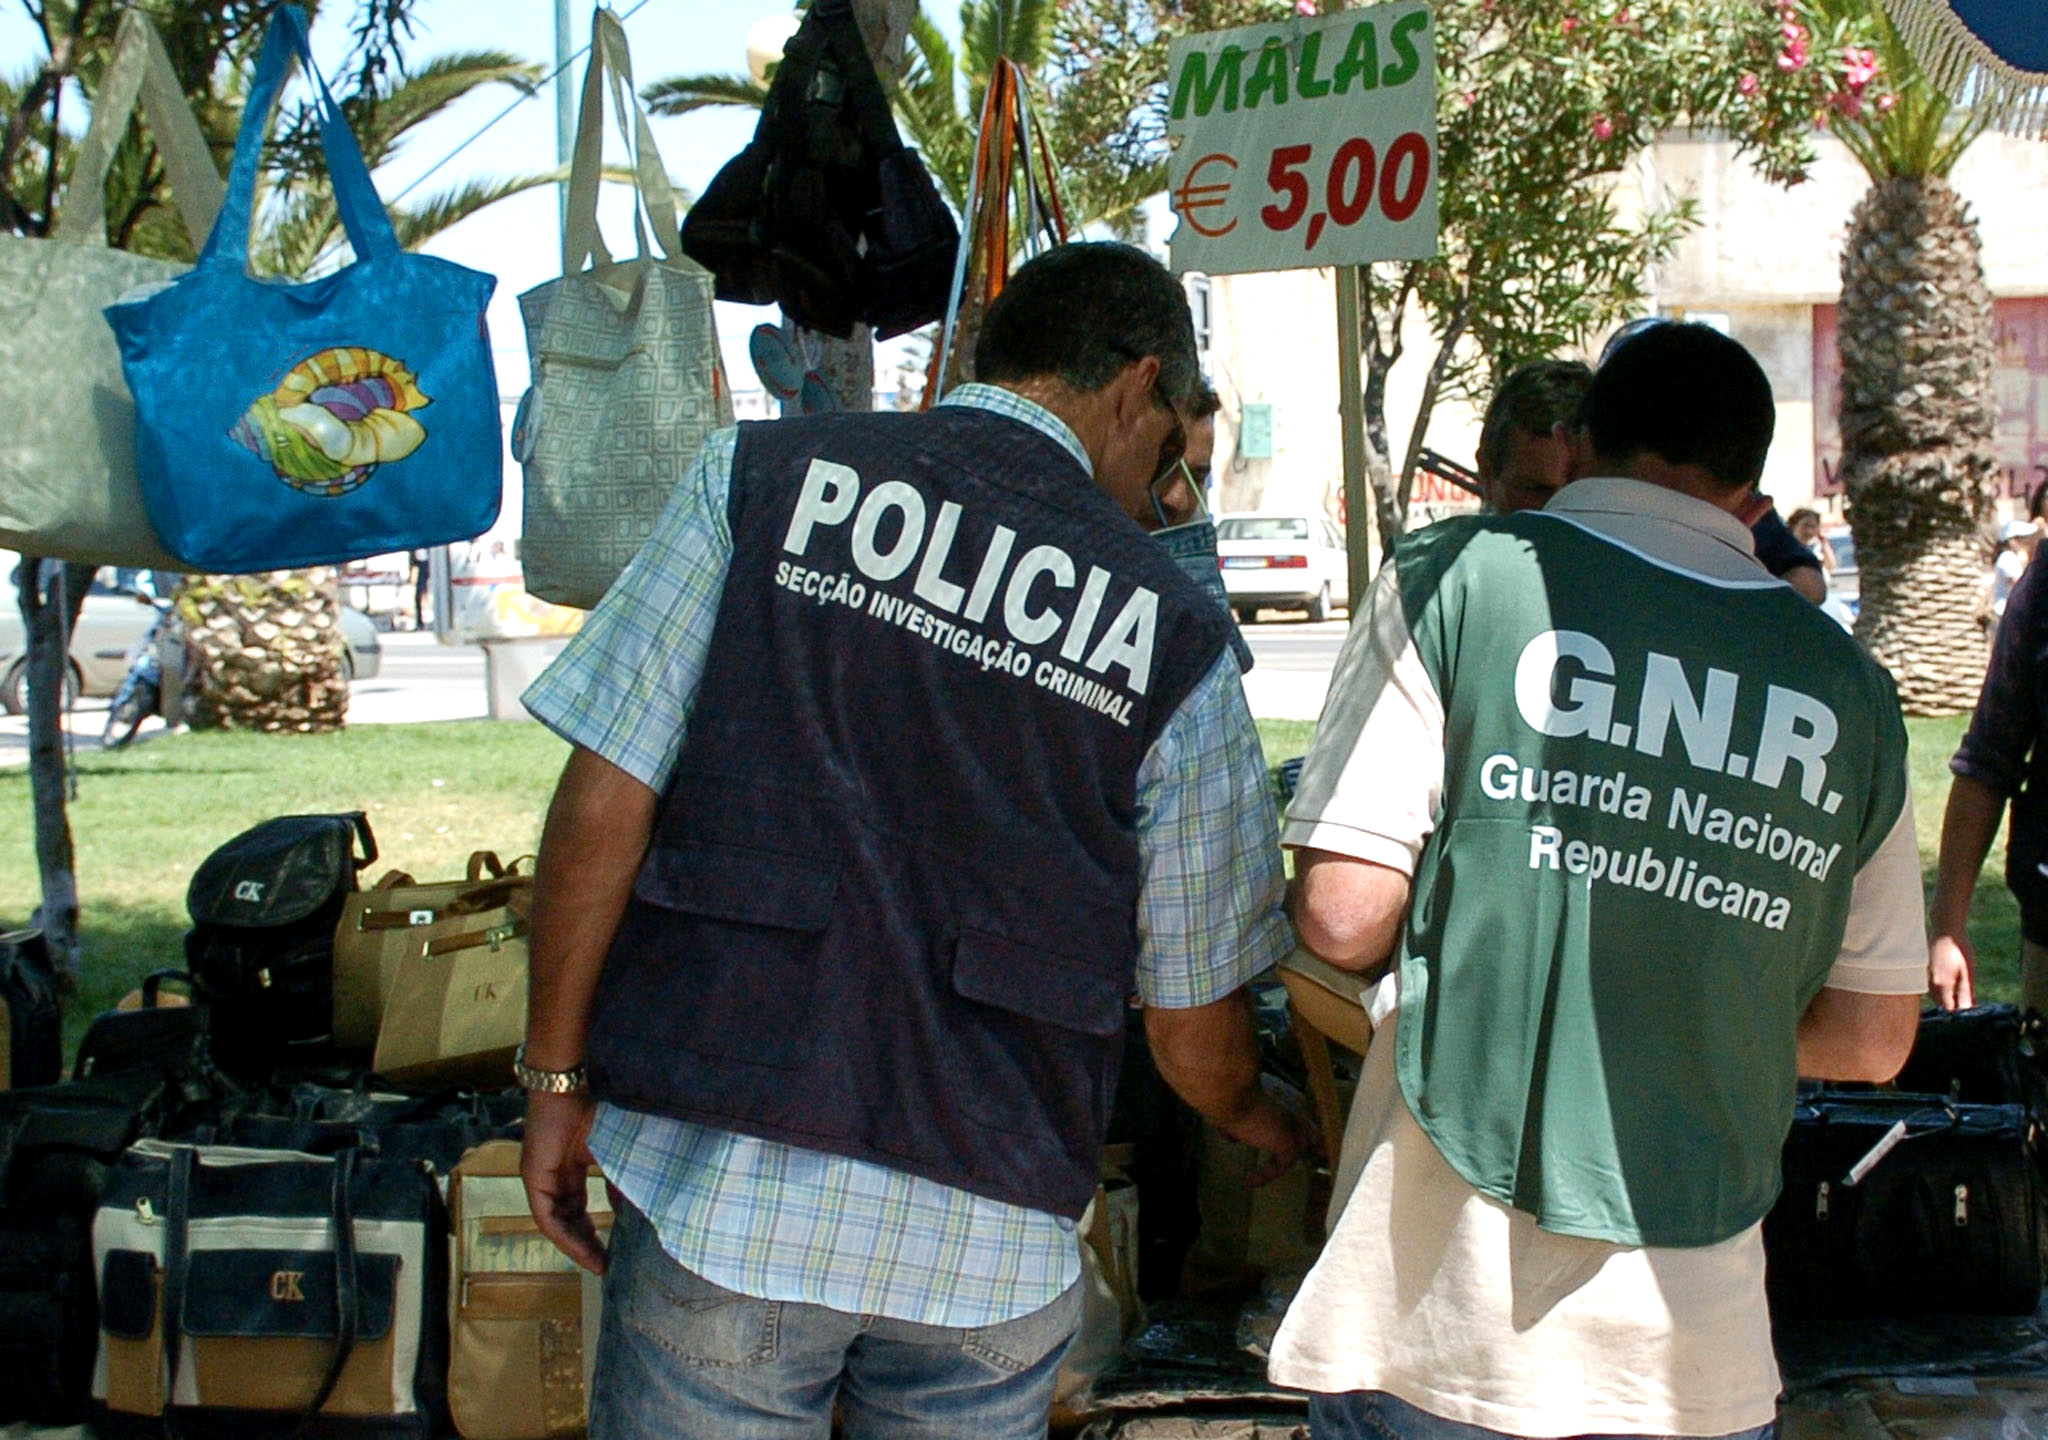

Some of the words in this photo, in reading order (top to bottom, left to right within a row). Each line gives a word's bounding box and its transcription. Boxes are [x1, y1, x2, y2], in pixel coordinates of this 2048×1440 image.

[1171, 10, 1428, 120] MALAS
[1260, 132, 1430, 250] 5,00
[783, 458, 1159, 696] POLICIA
[775, 560, 866, 609] SECÇÃO
[868, 590, 1032, 677] INVESTIGAÇÃO
[1034, 661, 1132, 727] CRIMINAL
[1514, 629, 1844, 815] G.N.R.
[1480, 753, 1652, 821] Guarda
[1668, 787, 1842, 883] Nacional
[234, 880, 264, 902] CK
[1528, 825, 1792, 931] Republicana
[270, 1270, 305, 1301] CK
